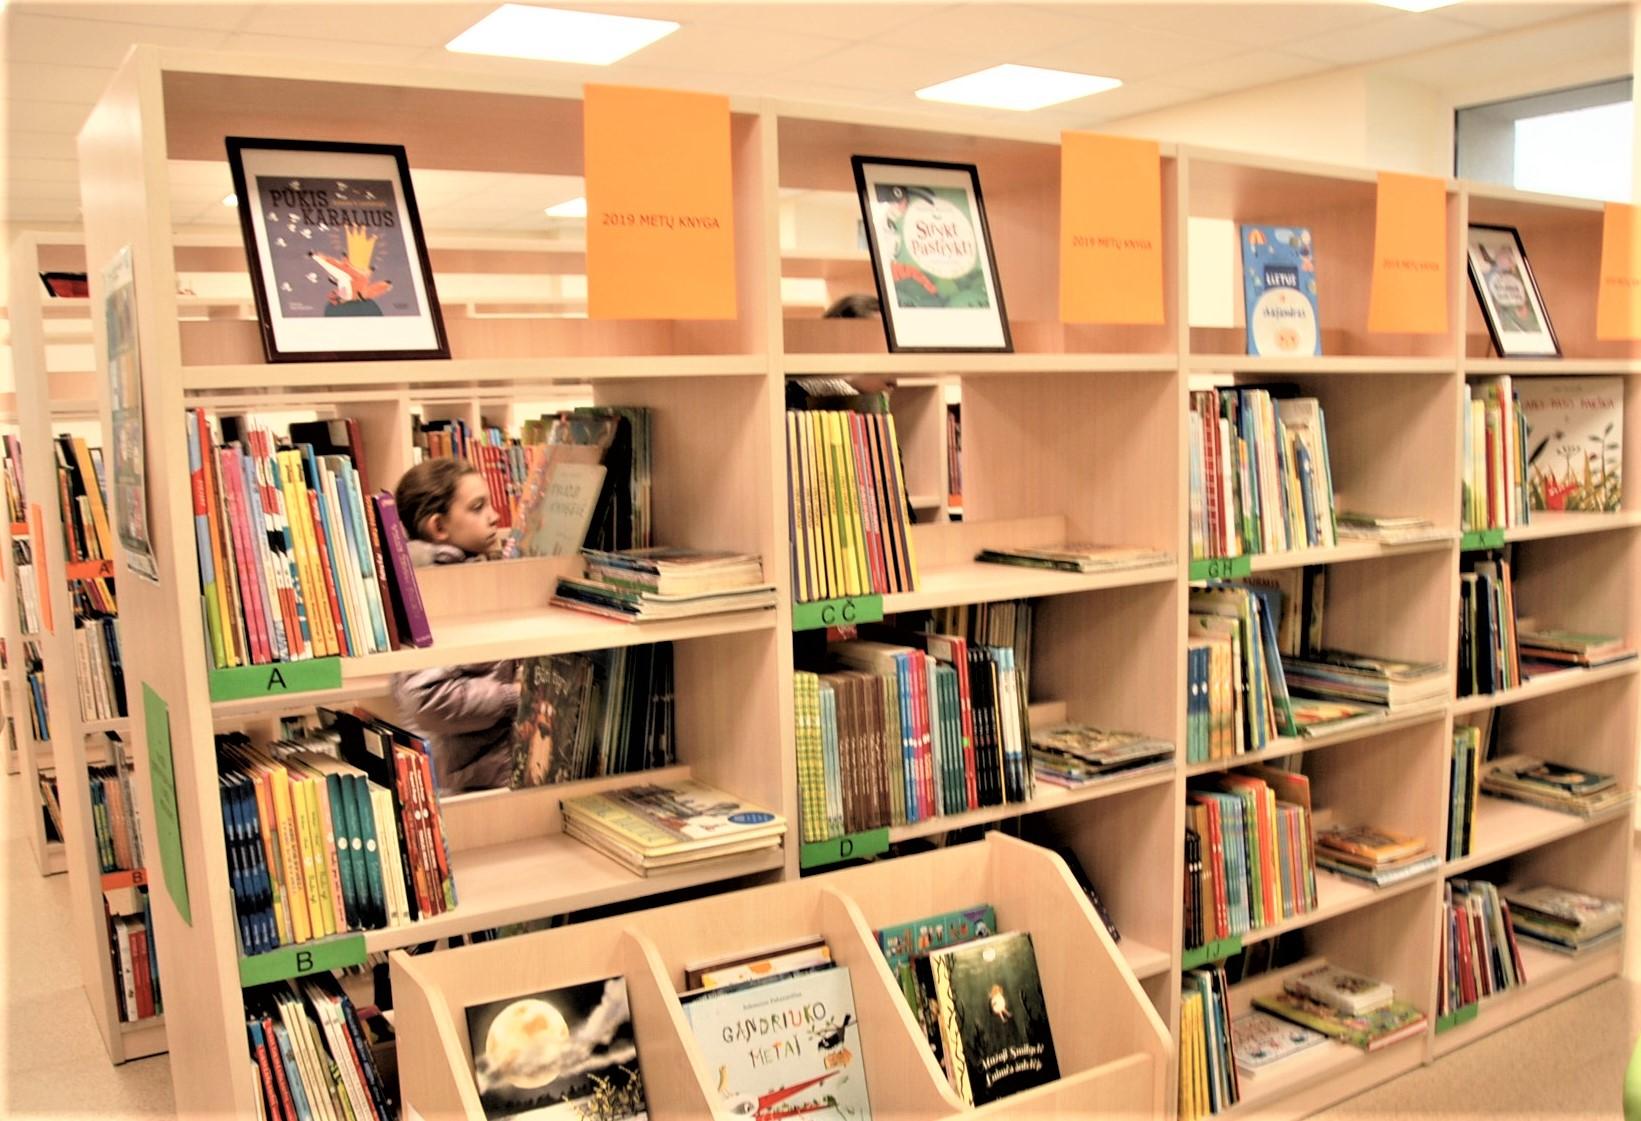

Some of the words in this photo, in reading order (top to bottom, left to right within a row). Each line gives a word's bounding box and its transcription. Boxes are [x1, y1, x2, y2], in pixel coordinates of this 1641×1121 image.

[302, 208, 395, 228] KARALIUS
[602, 213, 635, 227] 2019
[640, 214, 674, 230] METŲ
[679, 216, 720, 229] KNYGA
[266, 667, 287, 690] A
[840, 839, 854, 857] D
[296, 951, 314, 972] B
[722, 1001, 826, 1043] GANDRIUKO
[750, 1034, 801, 1068] METAI
